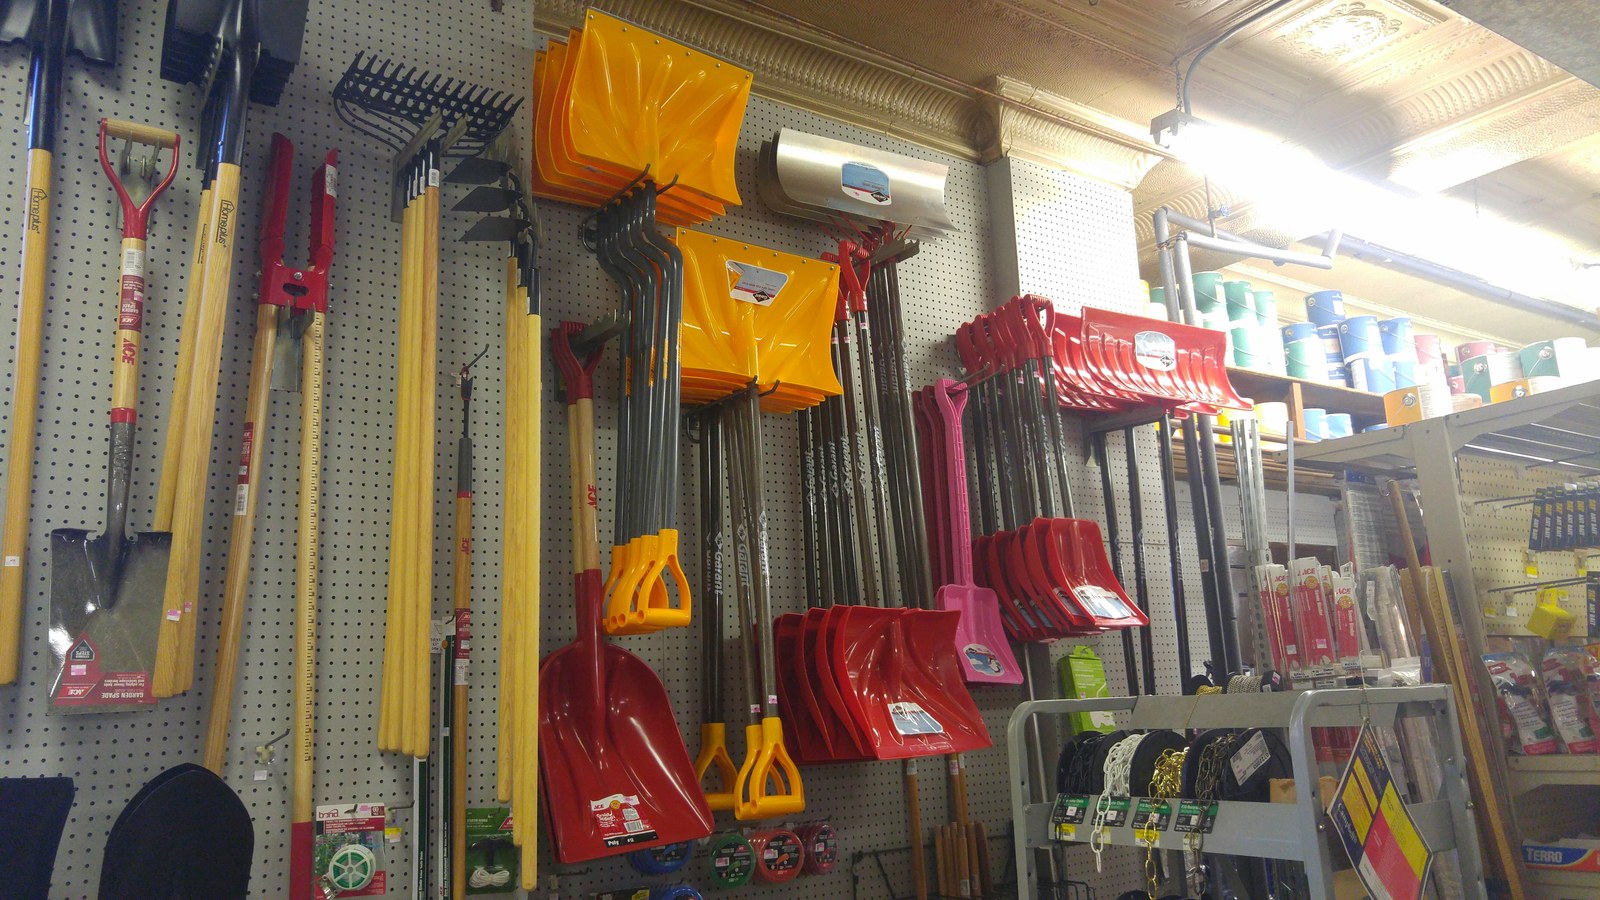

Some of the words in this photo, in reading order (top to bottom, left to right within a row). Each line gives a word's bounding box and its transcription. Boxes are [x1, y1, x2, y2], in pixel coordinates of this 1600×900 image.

[122, 338, 136, 365] ACE
[805, 450, 813, 489] Garant
[828, 441, 838, 480] Garant
[841, 436, 850, 477] Garant
[588, 484, 597, 510] ACE
[461, 537, 470, 555] ACE
[715, 552, 724, 595] Garant
[738, 544, 749, 586] Garant
[1336, 587, 1351, 595] ACE
[319, 809, 338, 818] bond
[1526, 847, 1564, 864] TERRO
